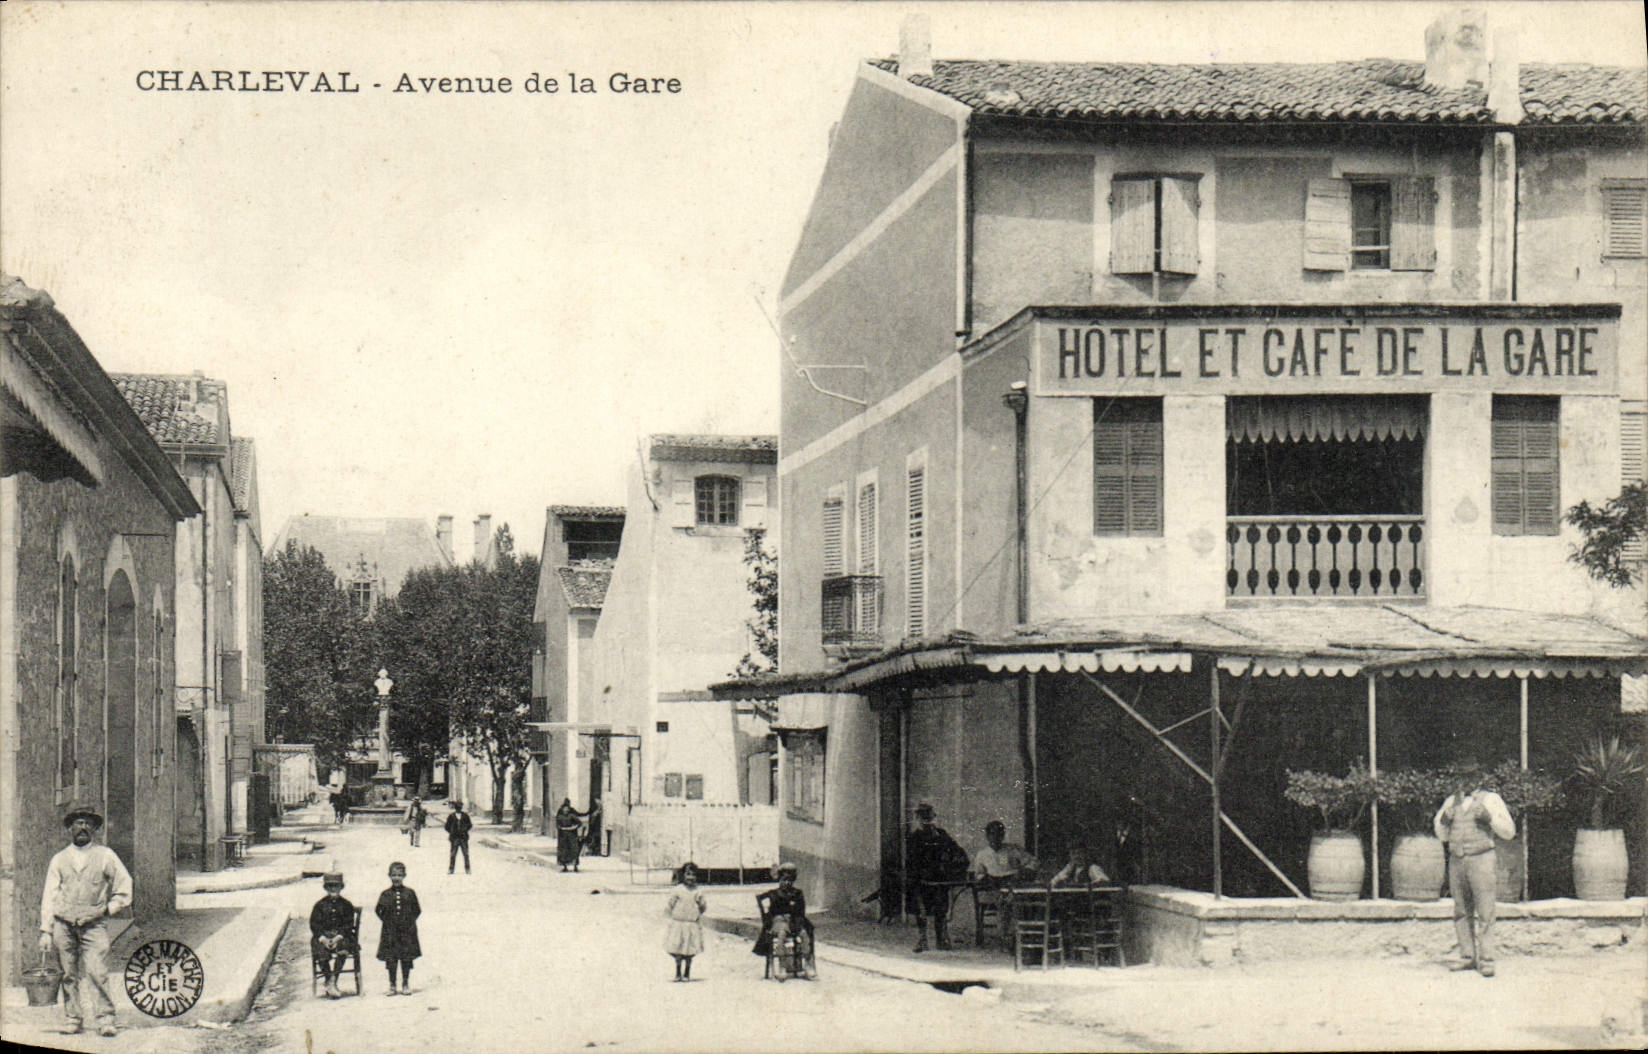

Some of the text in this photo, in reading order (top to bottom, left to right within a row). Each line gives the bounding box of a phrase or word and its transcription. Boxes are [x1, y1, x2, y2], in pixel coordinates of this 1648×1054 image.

[1198, 328, 1246, 378] ET
[1375, 327, 1424, 376] DE
[1440, 327, 1488, 376] LA
[1503, 327, 1599, 376] GARE
